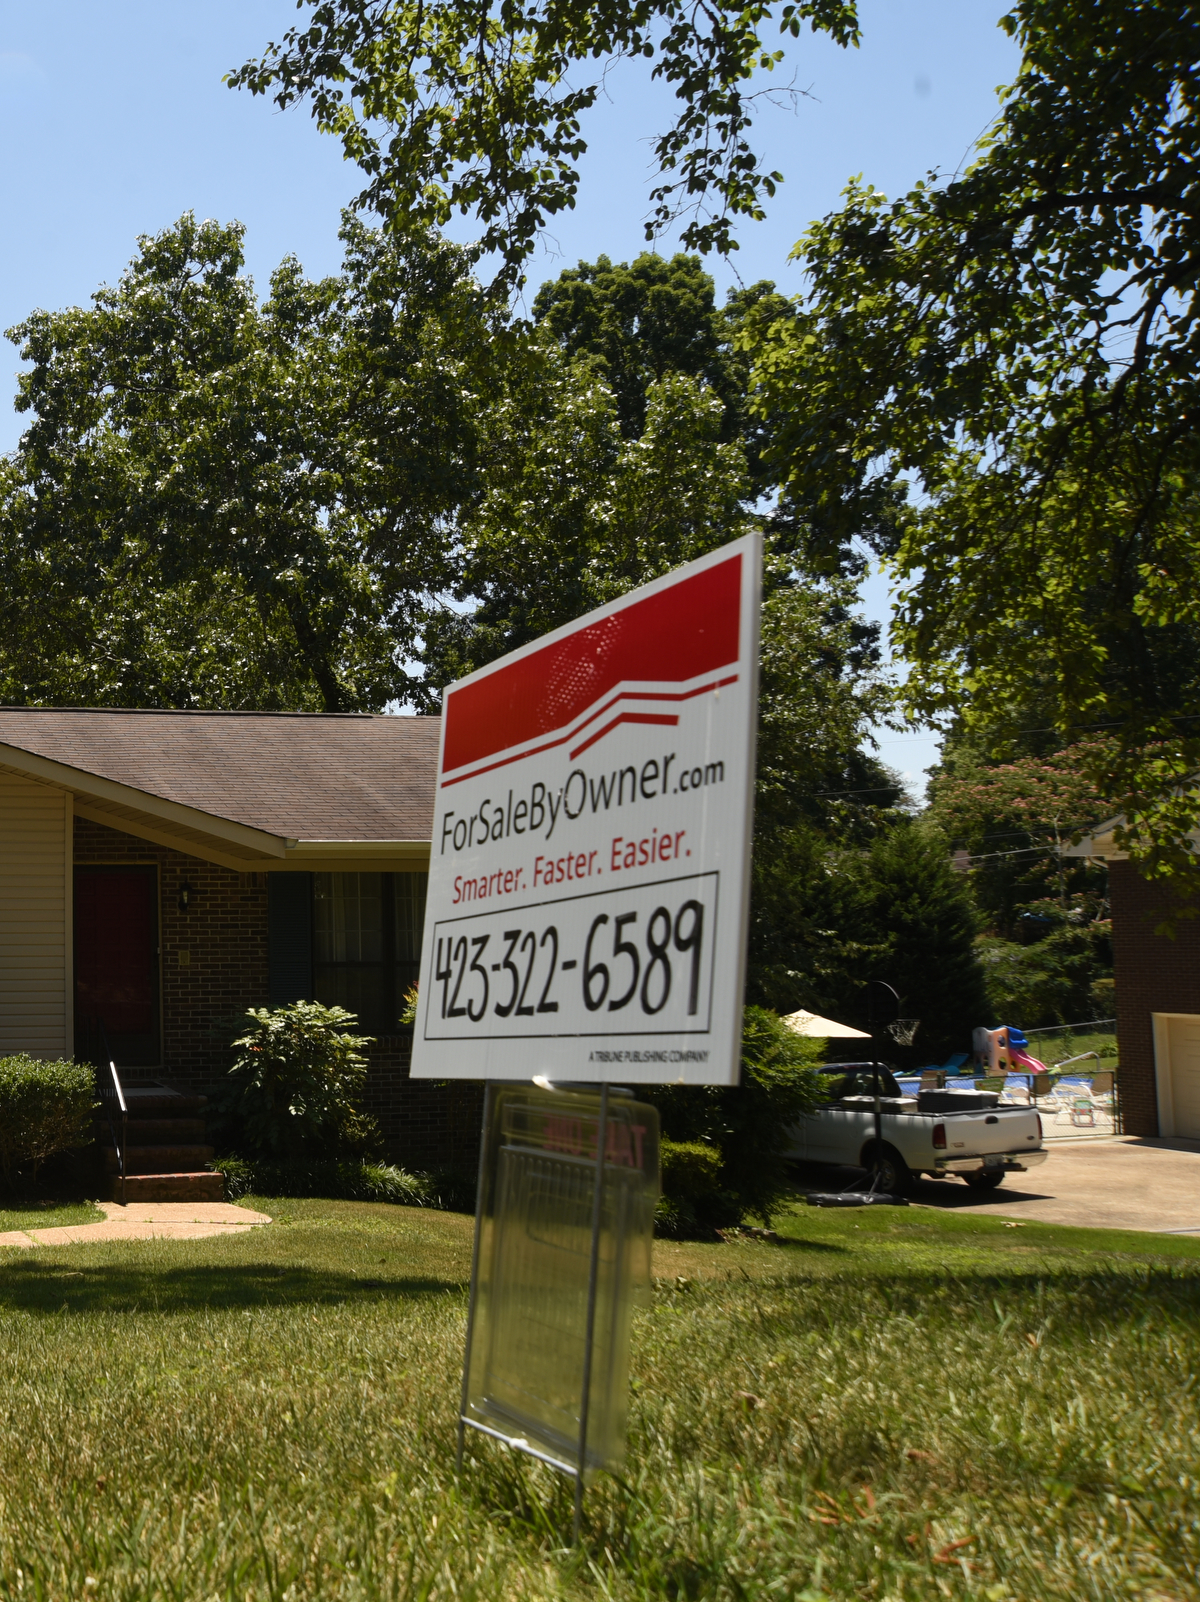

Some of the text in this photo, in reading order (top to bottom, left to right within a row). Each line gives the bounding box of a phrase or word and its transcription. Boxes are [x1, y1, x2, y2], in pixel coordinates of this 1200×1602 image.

[441, 752, 724, 855] ForSaleByOwner.com
[452, 828, 691, 904] Smarter. Faster. Easier.
[435, 899, 704, 1022] 423-322-6589
